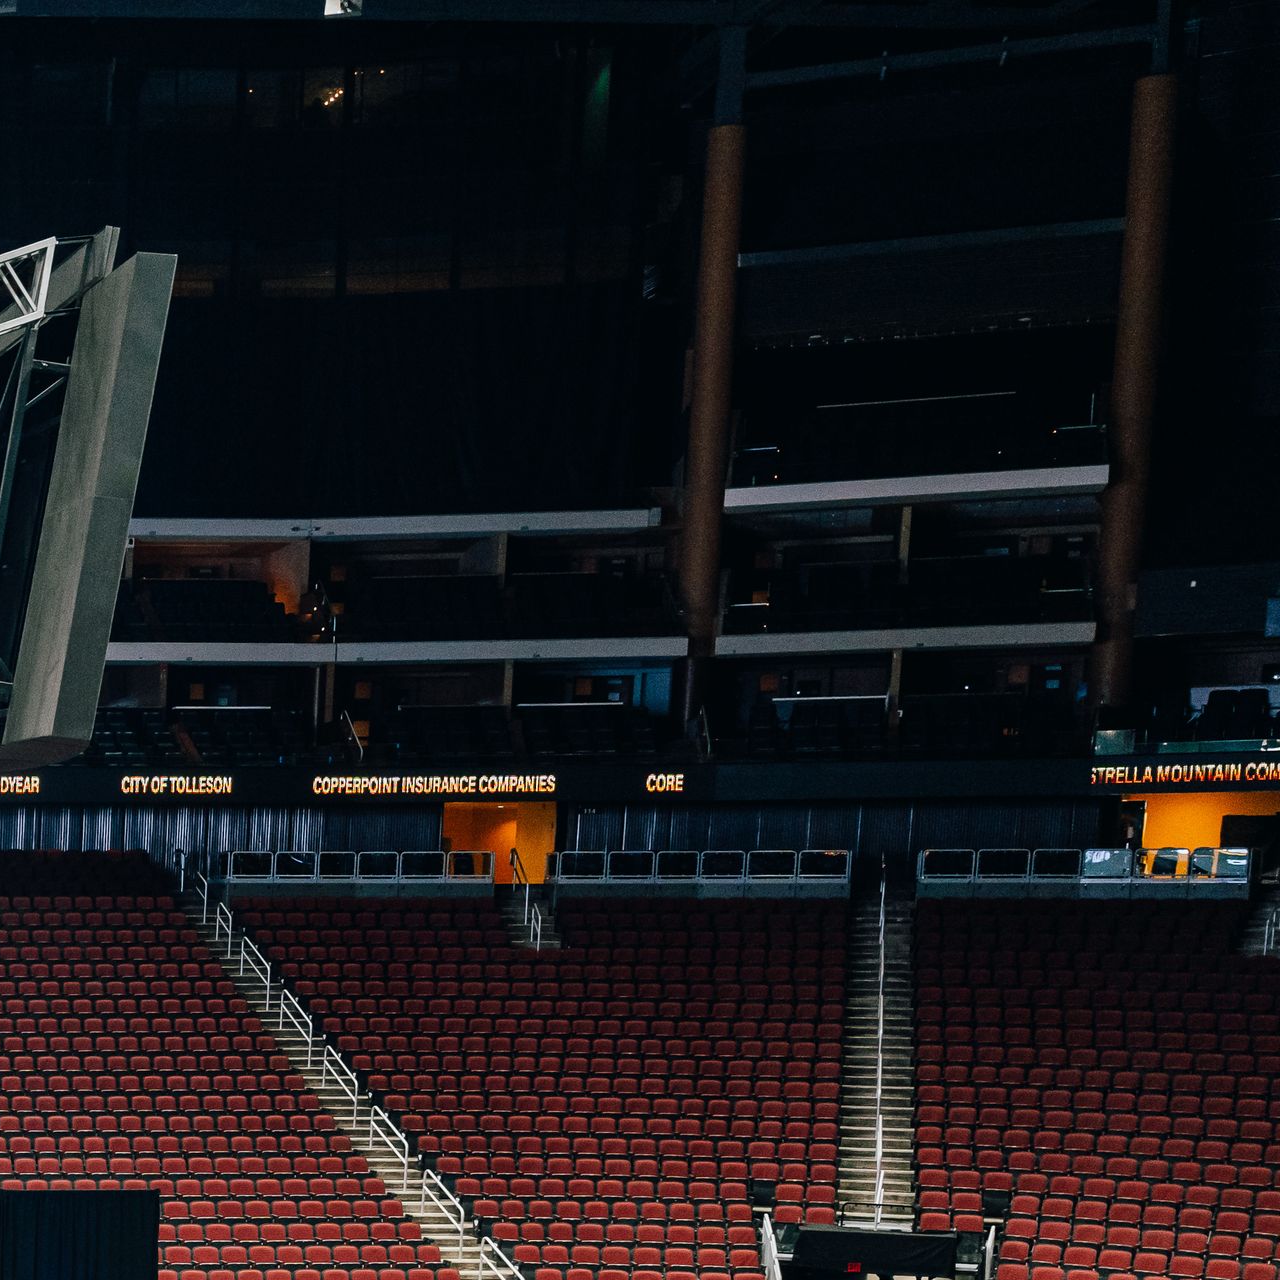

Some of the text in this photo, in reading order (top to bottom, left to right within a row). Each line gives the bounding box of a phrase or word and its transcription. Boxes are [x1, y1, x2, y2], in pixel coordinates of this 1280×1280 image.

[1156, 763, 1241, 783] MOUNTAIN
[121, 776, 232, 793] CITY OF TOLLESON
[313, 774, 556, 794] COPPERPOINT INSURANCE COMPANIES
[646, 774, 683, 792] CORE
